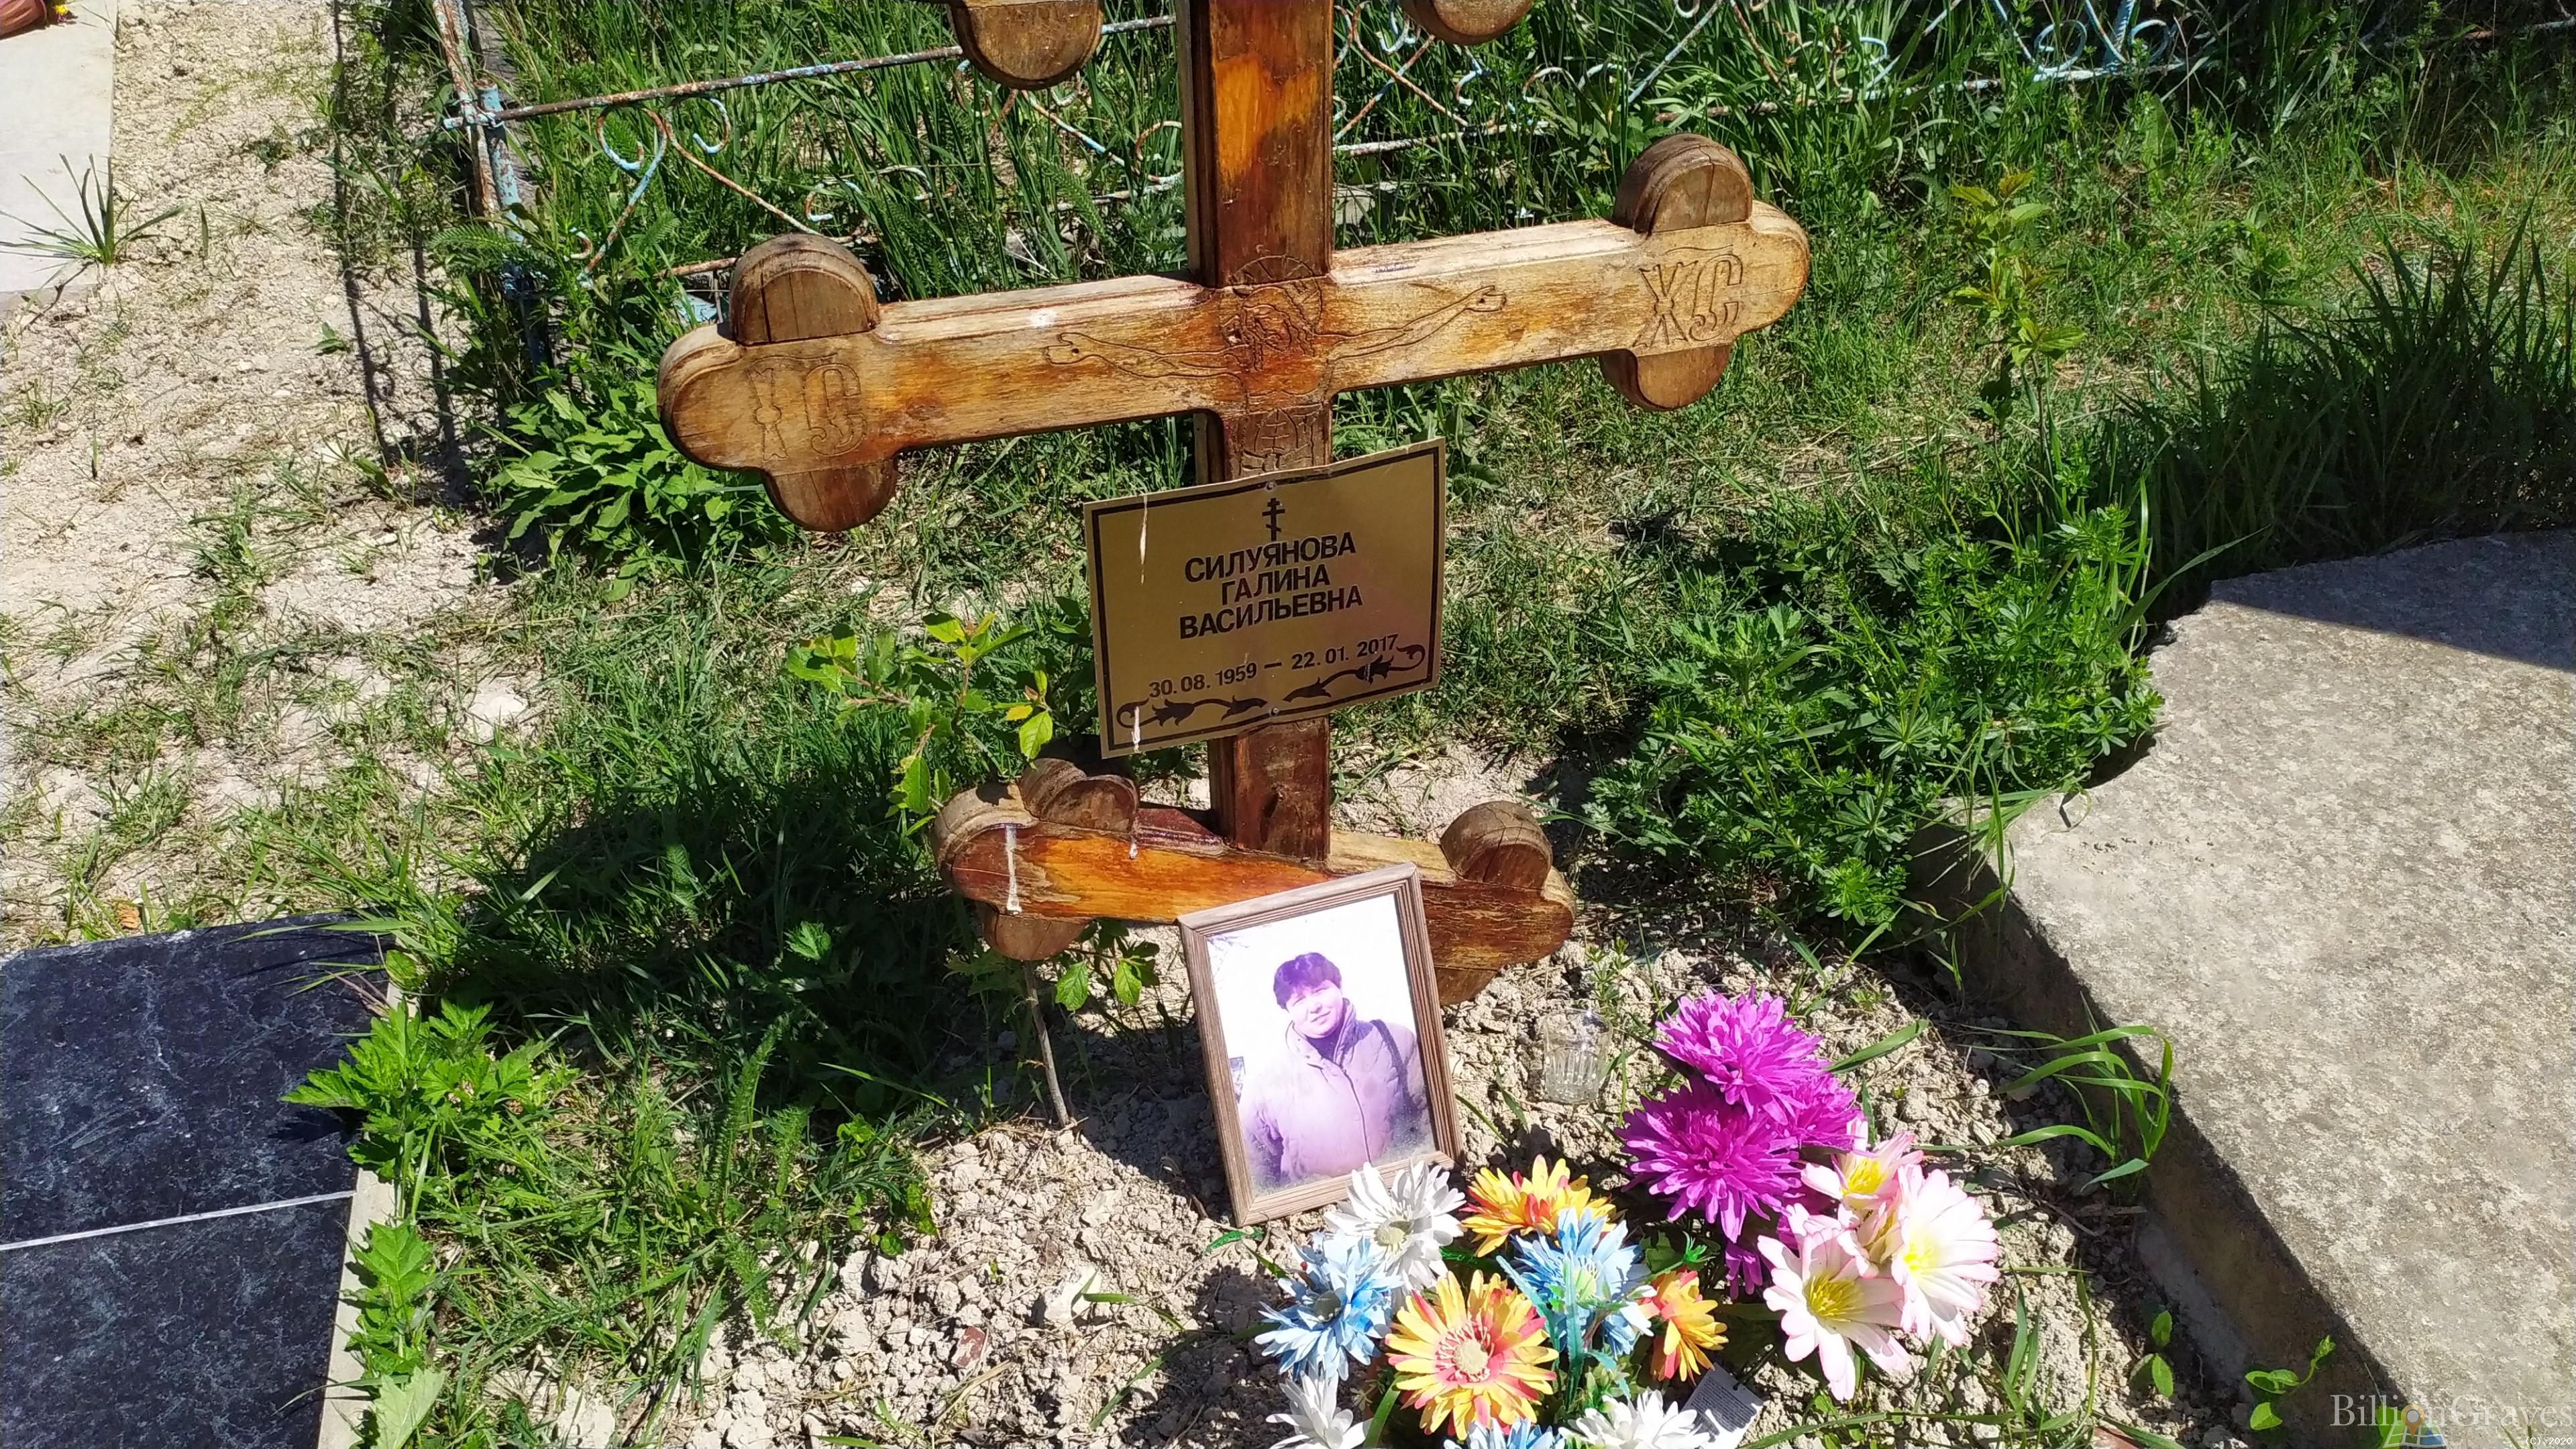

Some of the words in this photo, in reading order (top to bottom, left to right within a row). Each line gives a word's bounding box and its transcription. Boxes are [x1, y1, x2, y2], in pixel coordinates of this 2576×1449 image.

[1184, 531, 1356, 583] СИЛУЯНОВА
[1221, 564, 1331, 606] ГАЛИНА
[1179, 585, 1363, 639] ВАСИЛЬЕВНА
